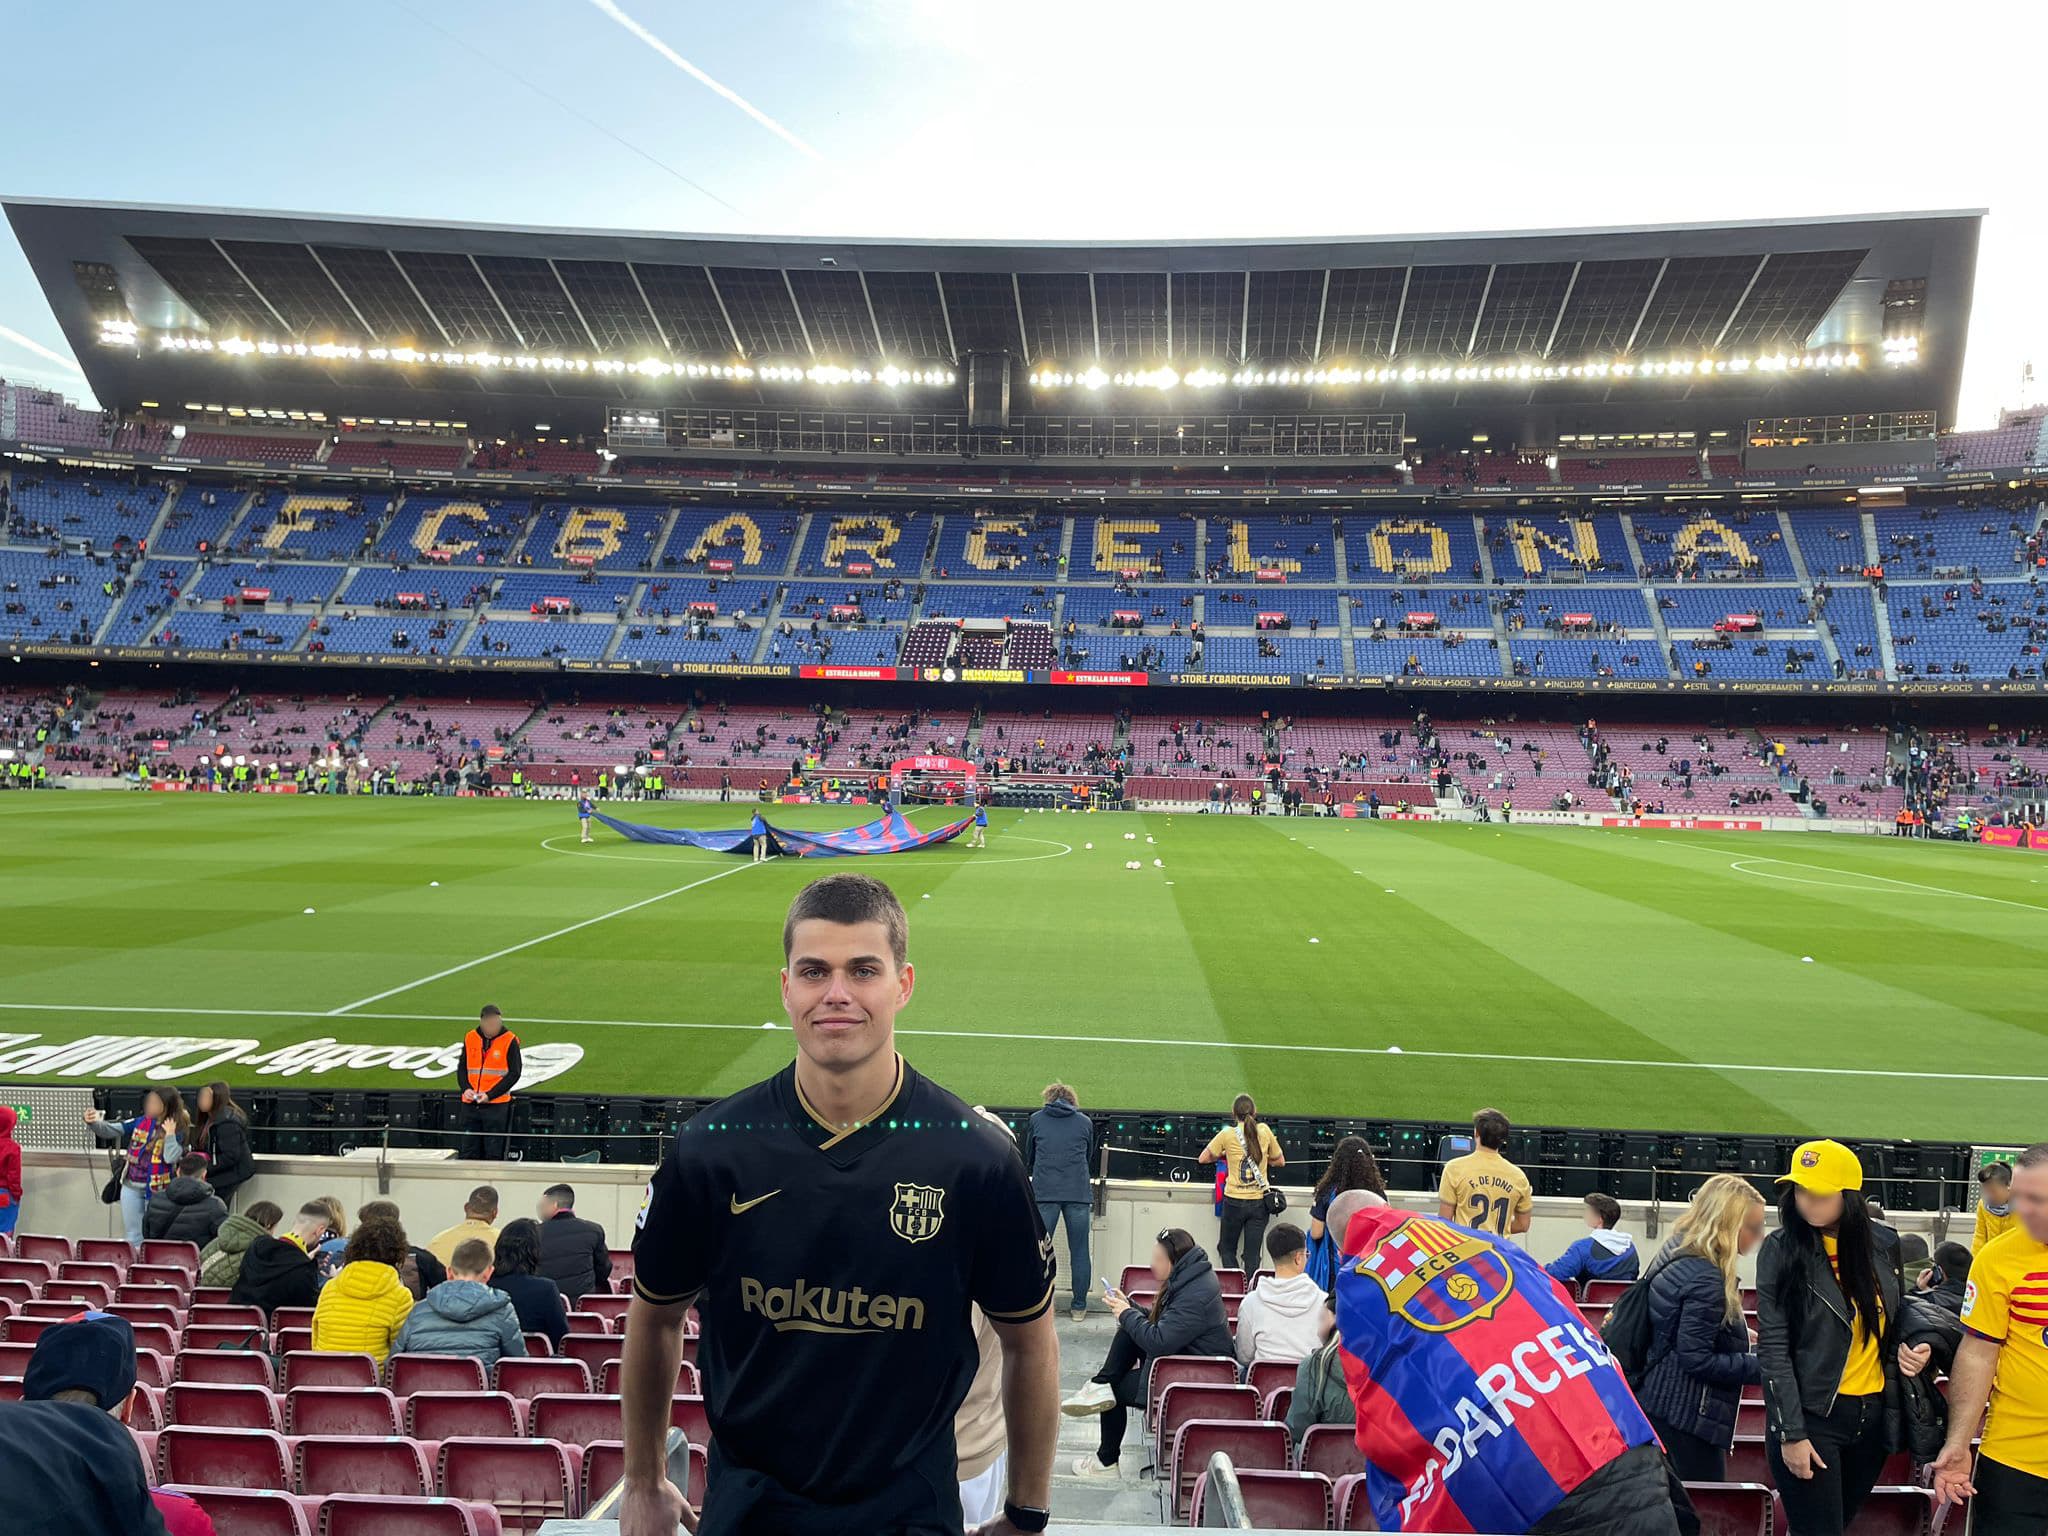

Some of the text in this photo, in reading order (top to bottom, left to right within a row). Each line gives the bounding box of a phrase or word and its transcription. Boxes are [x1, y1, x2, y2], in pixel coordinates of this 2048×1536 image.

[551, 504, 1760, 574] BARCELONA
[683, 663, 791, 675] STORE.FCBARCELONA.COM
[1180, 674, 1291, 685] STORE.FCBARCELONA.COM
[1469, 1175, 1513, 1193] F. DE JONG
[908, 1207, 927, 1217] FCB
[1468, 1193, 1511, 1239] 21
[1417, 1251, 1461, 1282] FCB
[740, 1276, 925, 1330] Rakuten
